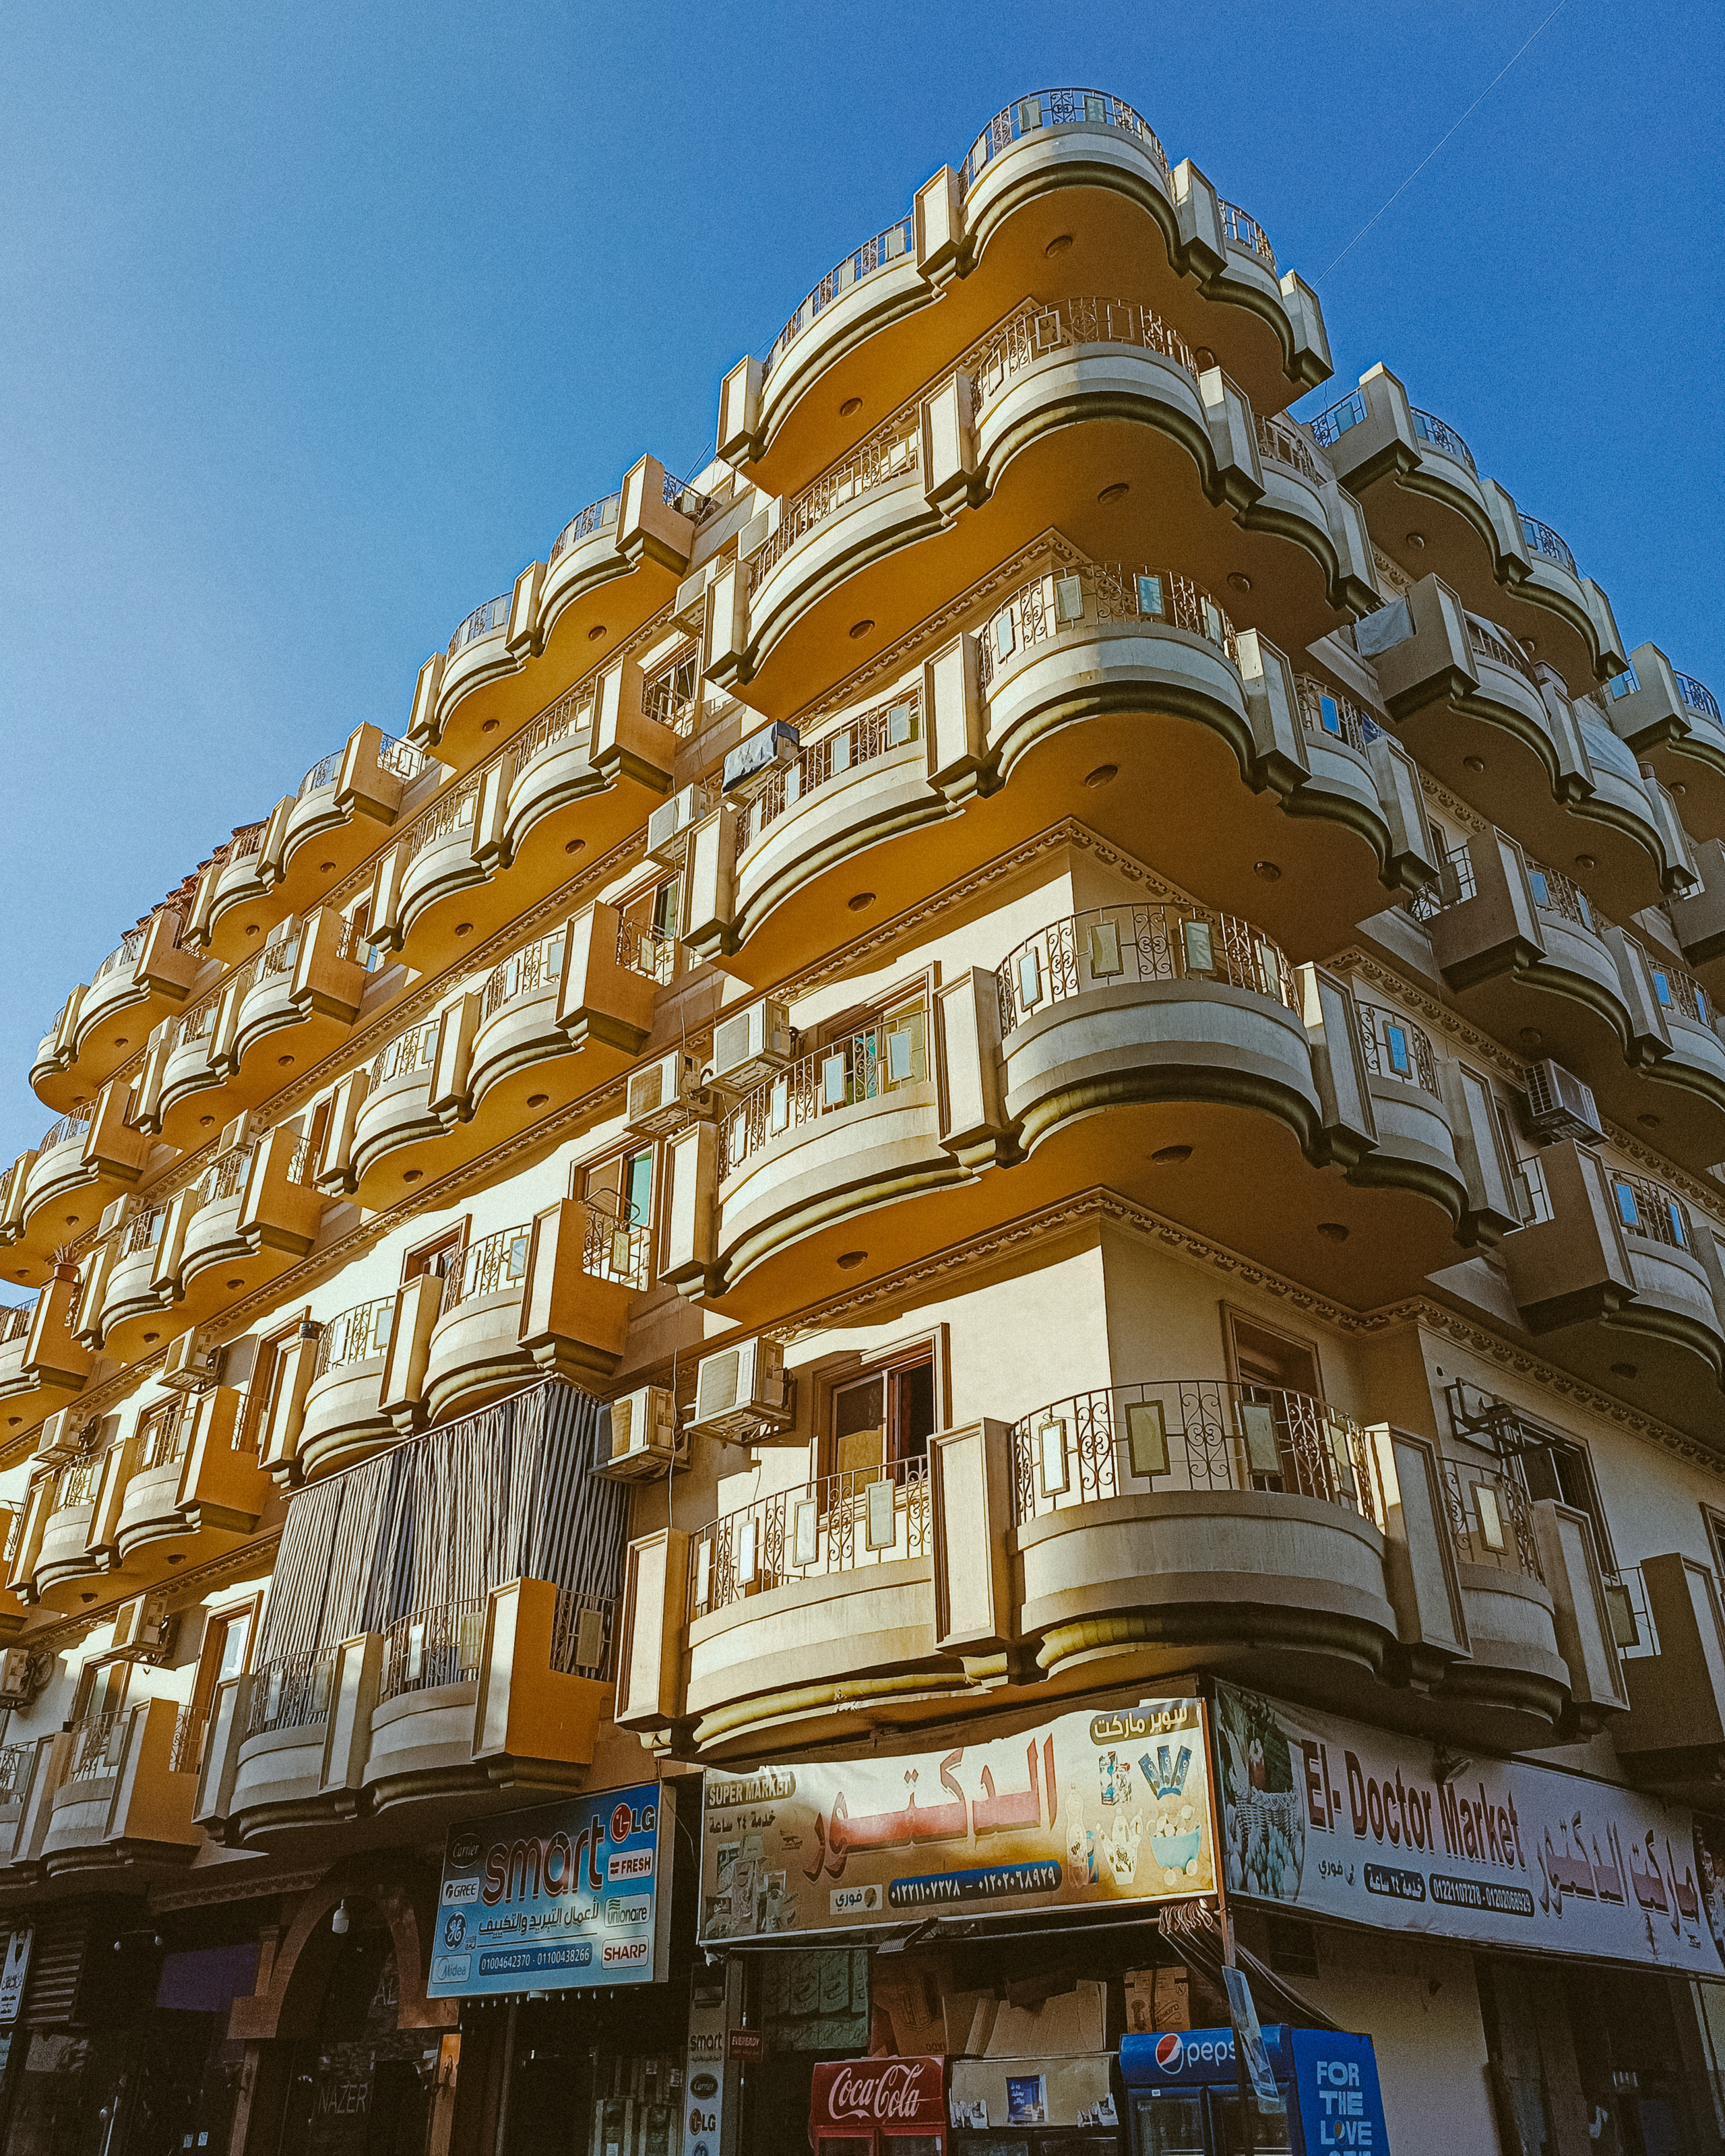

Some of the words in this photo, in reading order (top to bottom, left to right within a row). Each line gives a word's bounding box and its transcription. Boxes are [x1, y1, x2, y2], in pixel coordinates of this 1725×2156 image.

[1094, 1712, 1145, 1739] ماركت
[1150, 1706, 1188, 1734] سوبر
[709, 1783, 743, 1806] SUPER
[745, 1775, 792, 1801] MARKET
[751, 1810, 776, 1828] خدمة
[803, 1733, 1058, 1882] الدكتور
[1344, 1750, 1435, 1855] Doctor
[1436, 1781, 1527, 1872] Market
[709, 1816, 733, 1834] ساعة
[736, 1816, 747, 1830] ٢٤
[452, 1843, 480, 1859] Carrier
[481, 1814, 606, 1907] smart
[620, 1855, 652, 1875] FRESH
[1318, 1859, 1344, 1880] فوري
[1538, 1810, 1630, 1919] الدكتور
[453, 1882, 478, 1897] GREE
[891, 1878, 961, 1903] ٠١٢٢١١٠٧٢٧٨
[978, 1866, 1056, 1891] ٠١٢٠٢٠٦٨٩٢٩
[1400, 1872, 1422, 1899] خدمة
[1629, 1828, 1701, 1940] ماركت
[835, 1889, 862, 1911] فوري
[1433, 1883, 1482, 1906] 01221107278
[1486, 1890, 1532, 1913] 01202068929
[478, 1912, 528, 1938] والتكييف
[528, 1907, 563, 1933] التبريد
[563, 1896, 599, 1928] لأعمال
[481, 1954, 531, 1971] 01004642370
[537, 1948, 590, 1966] 01100438266
[604, 1944, 647, 1962] SHARP
[441, 1960, 467, 1978] Midea
[691, 2031, 722, 2052] smart
[731, 2036, 760, 2047] EVEREADY
[1187, 2041, 1236, 2068] peps
[693, 2081, 714, 2091] Carrier
[1316, 2060, 1360, 2087] FOR
[317, 2082, 369, 2114] NAZER
[828, 2064, 927, 2120] Coca-Cola
[1319, 2090, 1364, 2116] THE
[1320, 2120, 1373, 2145] LOVE
